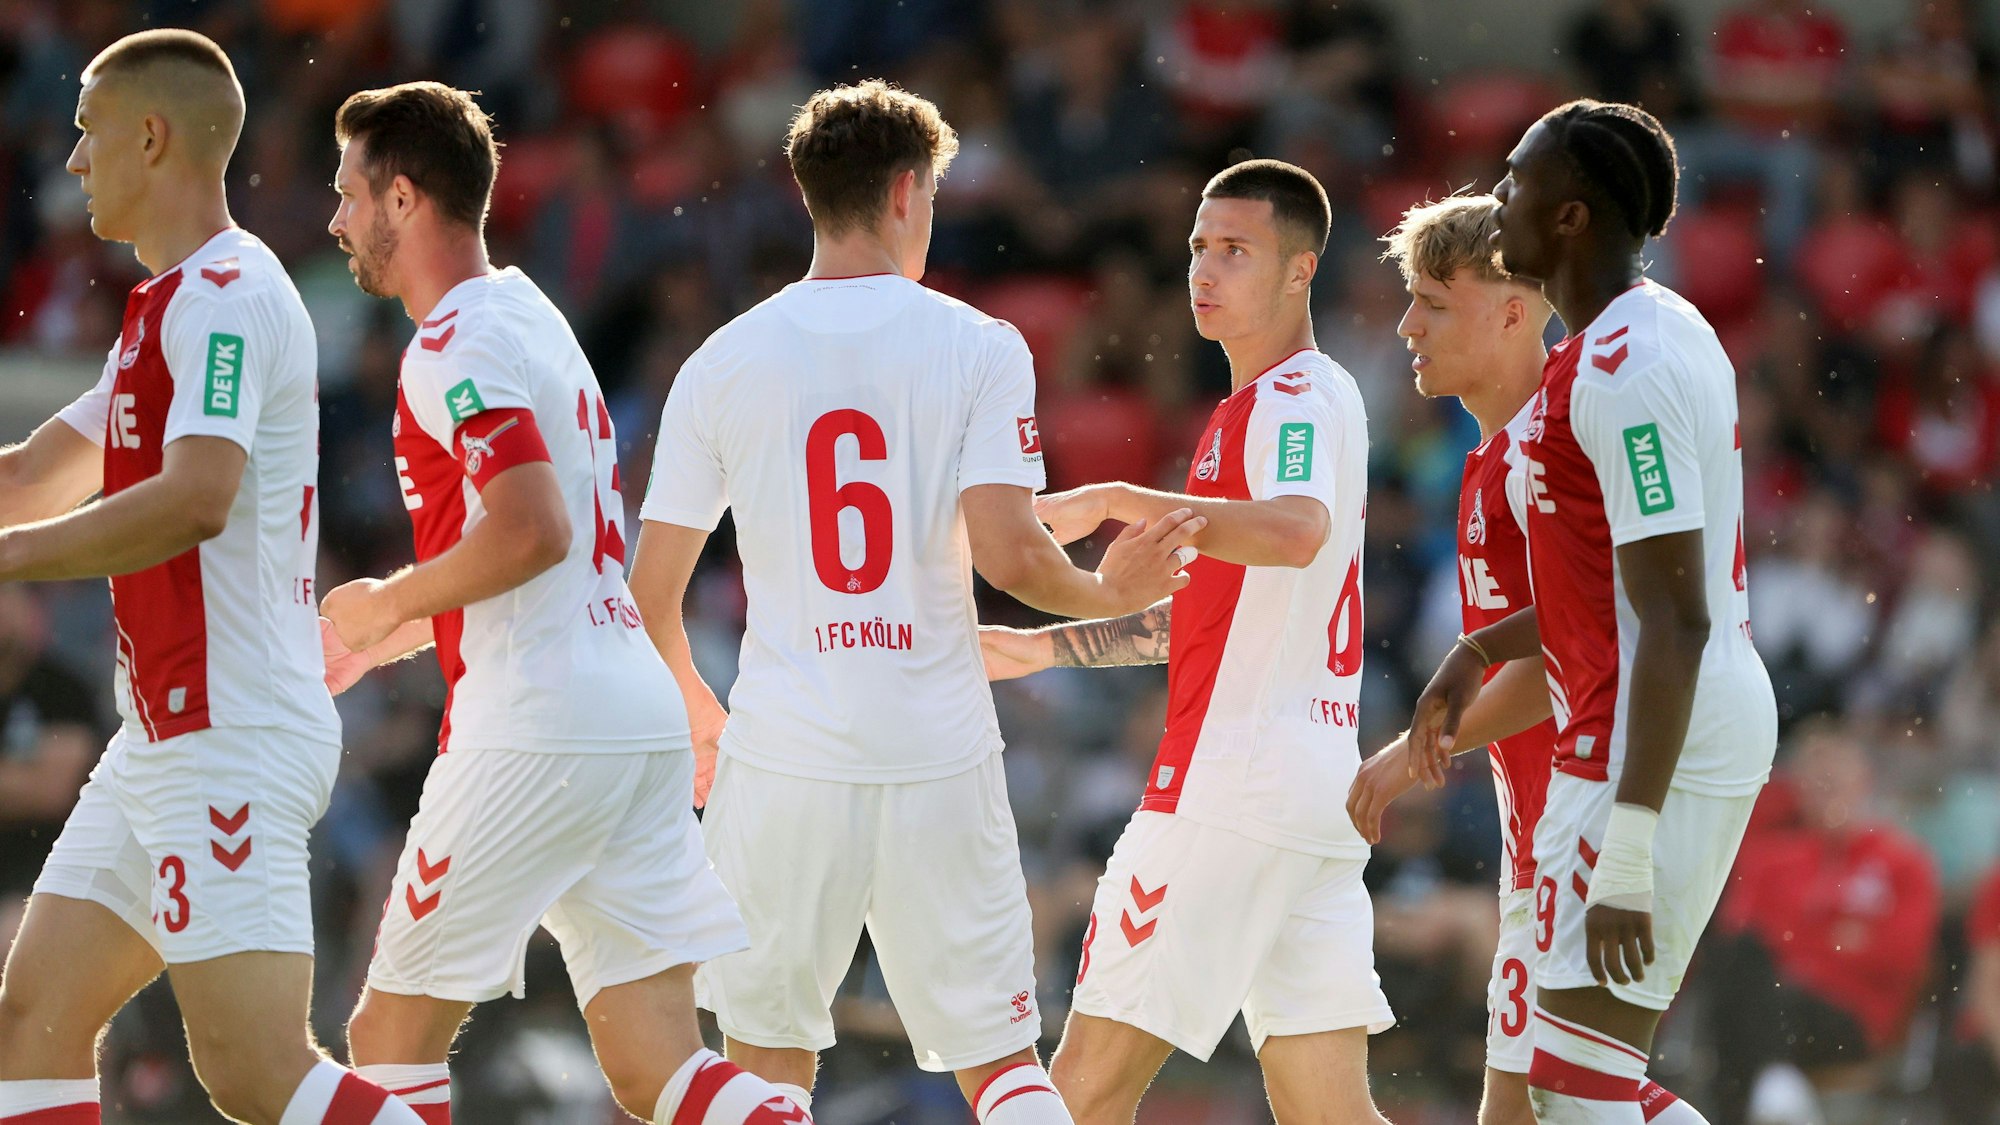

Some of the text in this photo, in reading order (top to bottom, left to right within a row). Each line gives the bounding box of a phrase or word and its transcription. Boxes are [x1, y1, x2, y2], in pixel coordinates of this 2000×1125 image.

[211, 341, 237, 410] DEVK
[1285, 429, 1306, 478] DEVK
[1632, 432, 1667, 507] DEVK
[806, 408, 893, 594] 6
[815, 616, 912, 653] 1. FC KÖLN
[1321, 700, 1344, 727] FC
[152, 854, 190, 933] 3
[1536, 875, 1558, 953] 9
